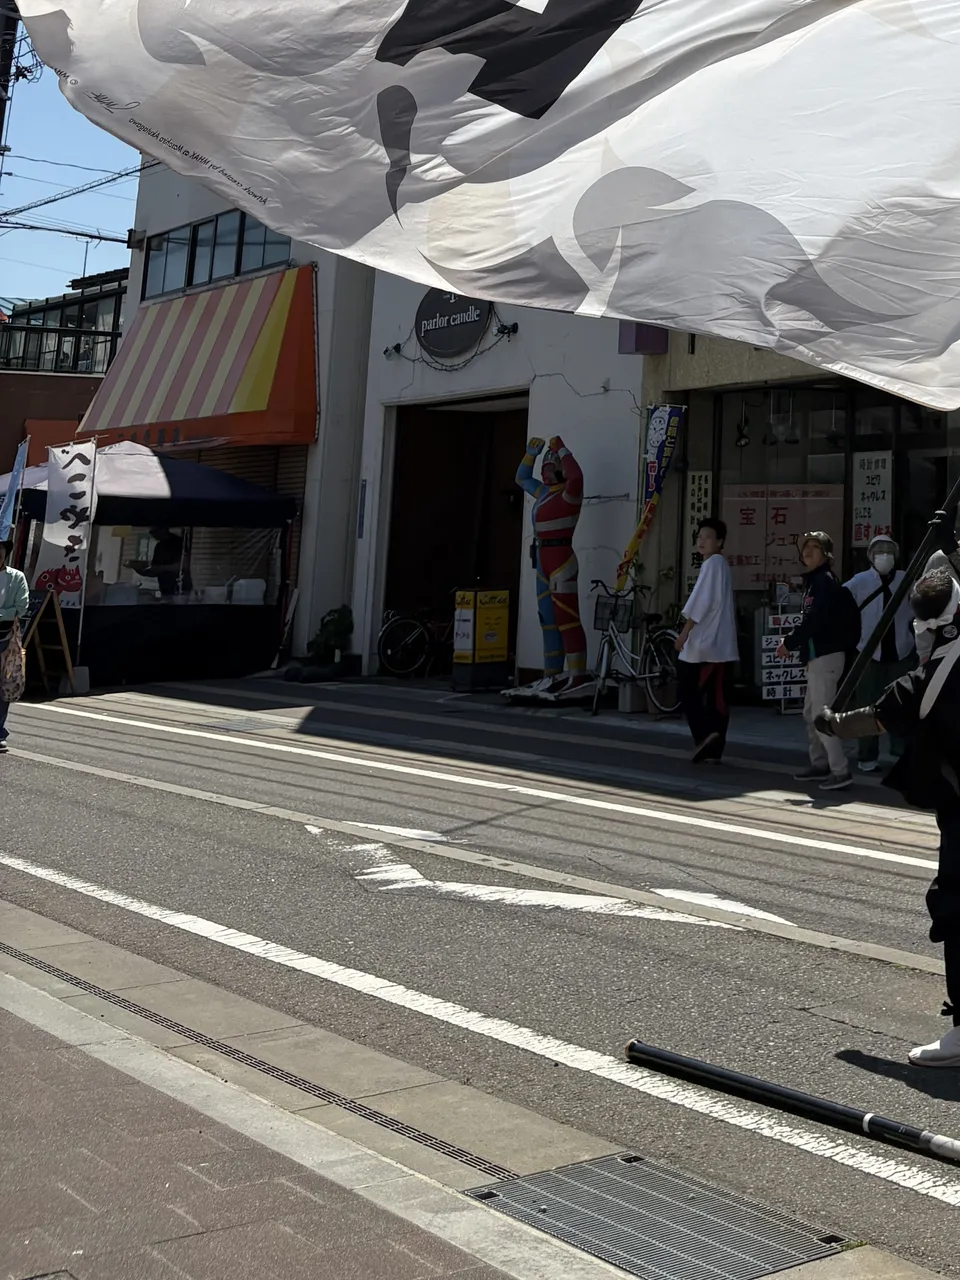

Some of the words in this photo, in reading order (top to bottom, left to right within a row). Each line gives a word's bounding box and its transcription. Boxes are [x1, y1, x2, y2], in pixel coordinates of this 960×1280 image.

[421, 312, 448, 336] parlor
[449, 305, 481, 326] candle
[739, 506, 789, 526] 宝石
[766, 668, 805, 681] ネックレス
